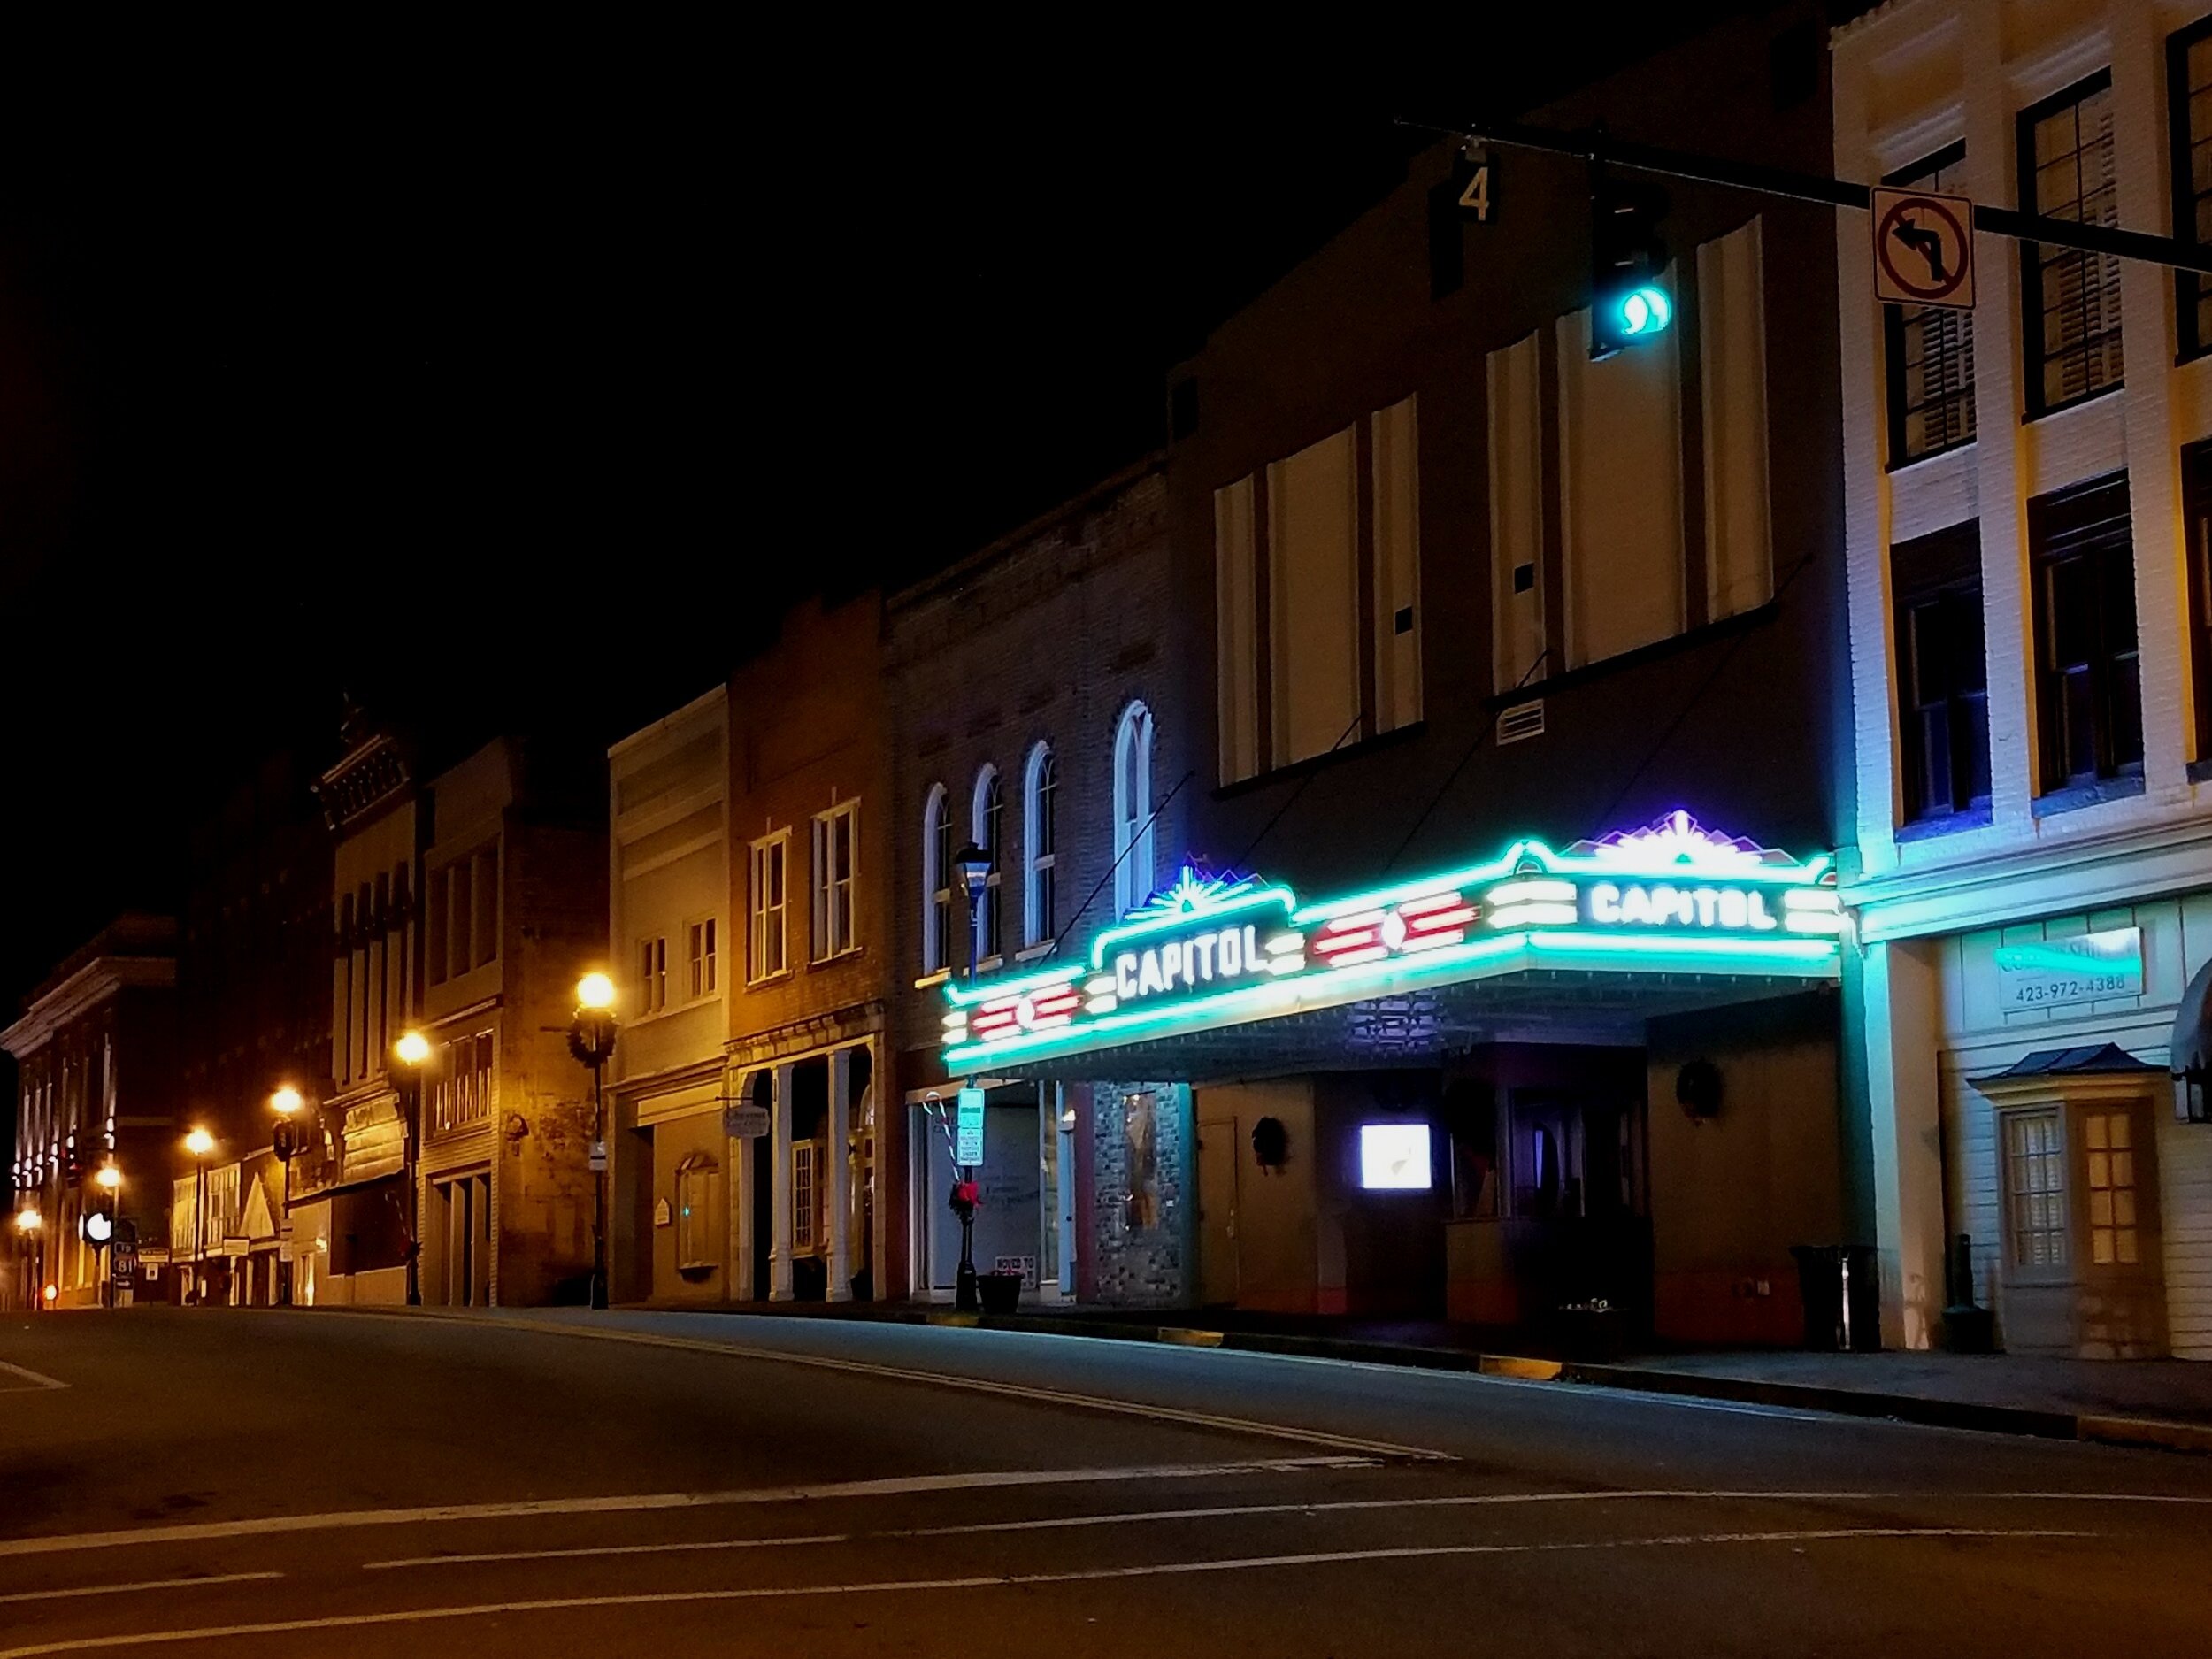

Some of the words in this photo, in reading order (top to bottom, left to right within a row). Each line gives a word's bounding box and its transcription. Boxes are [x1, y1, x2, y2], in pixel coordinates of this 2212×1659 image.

[1458, 166, 1490, 221] 4
[1590, 883, 1778, 930] CAPITOL
[1116, 924, 1269, 1000] CAPITOL
[2016, 973, 2125, 1002] 423-972-4388
[1024, 1257, 1033, 1269] TO
